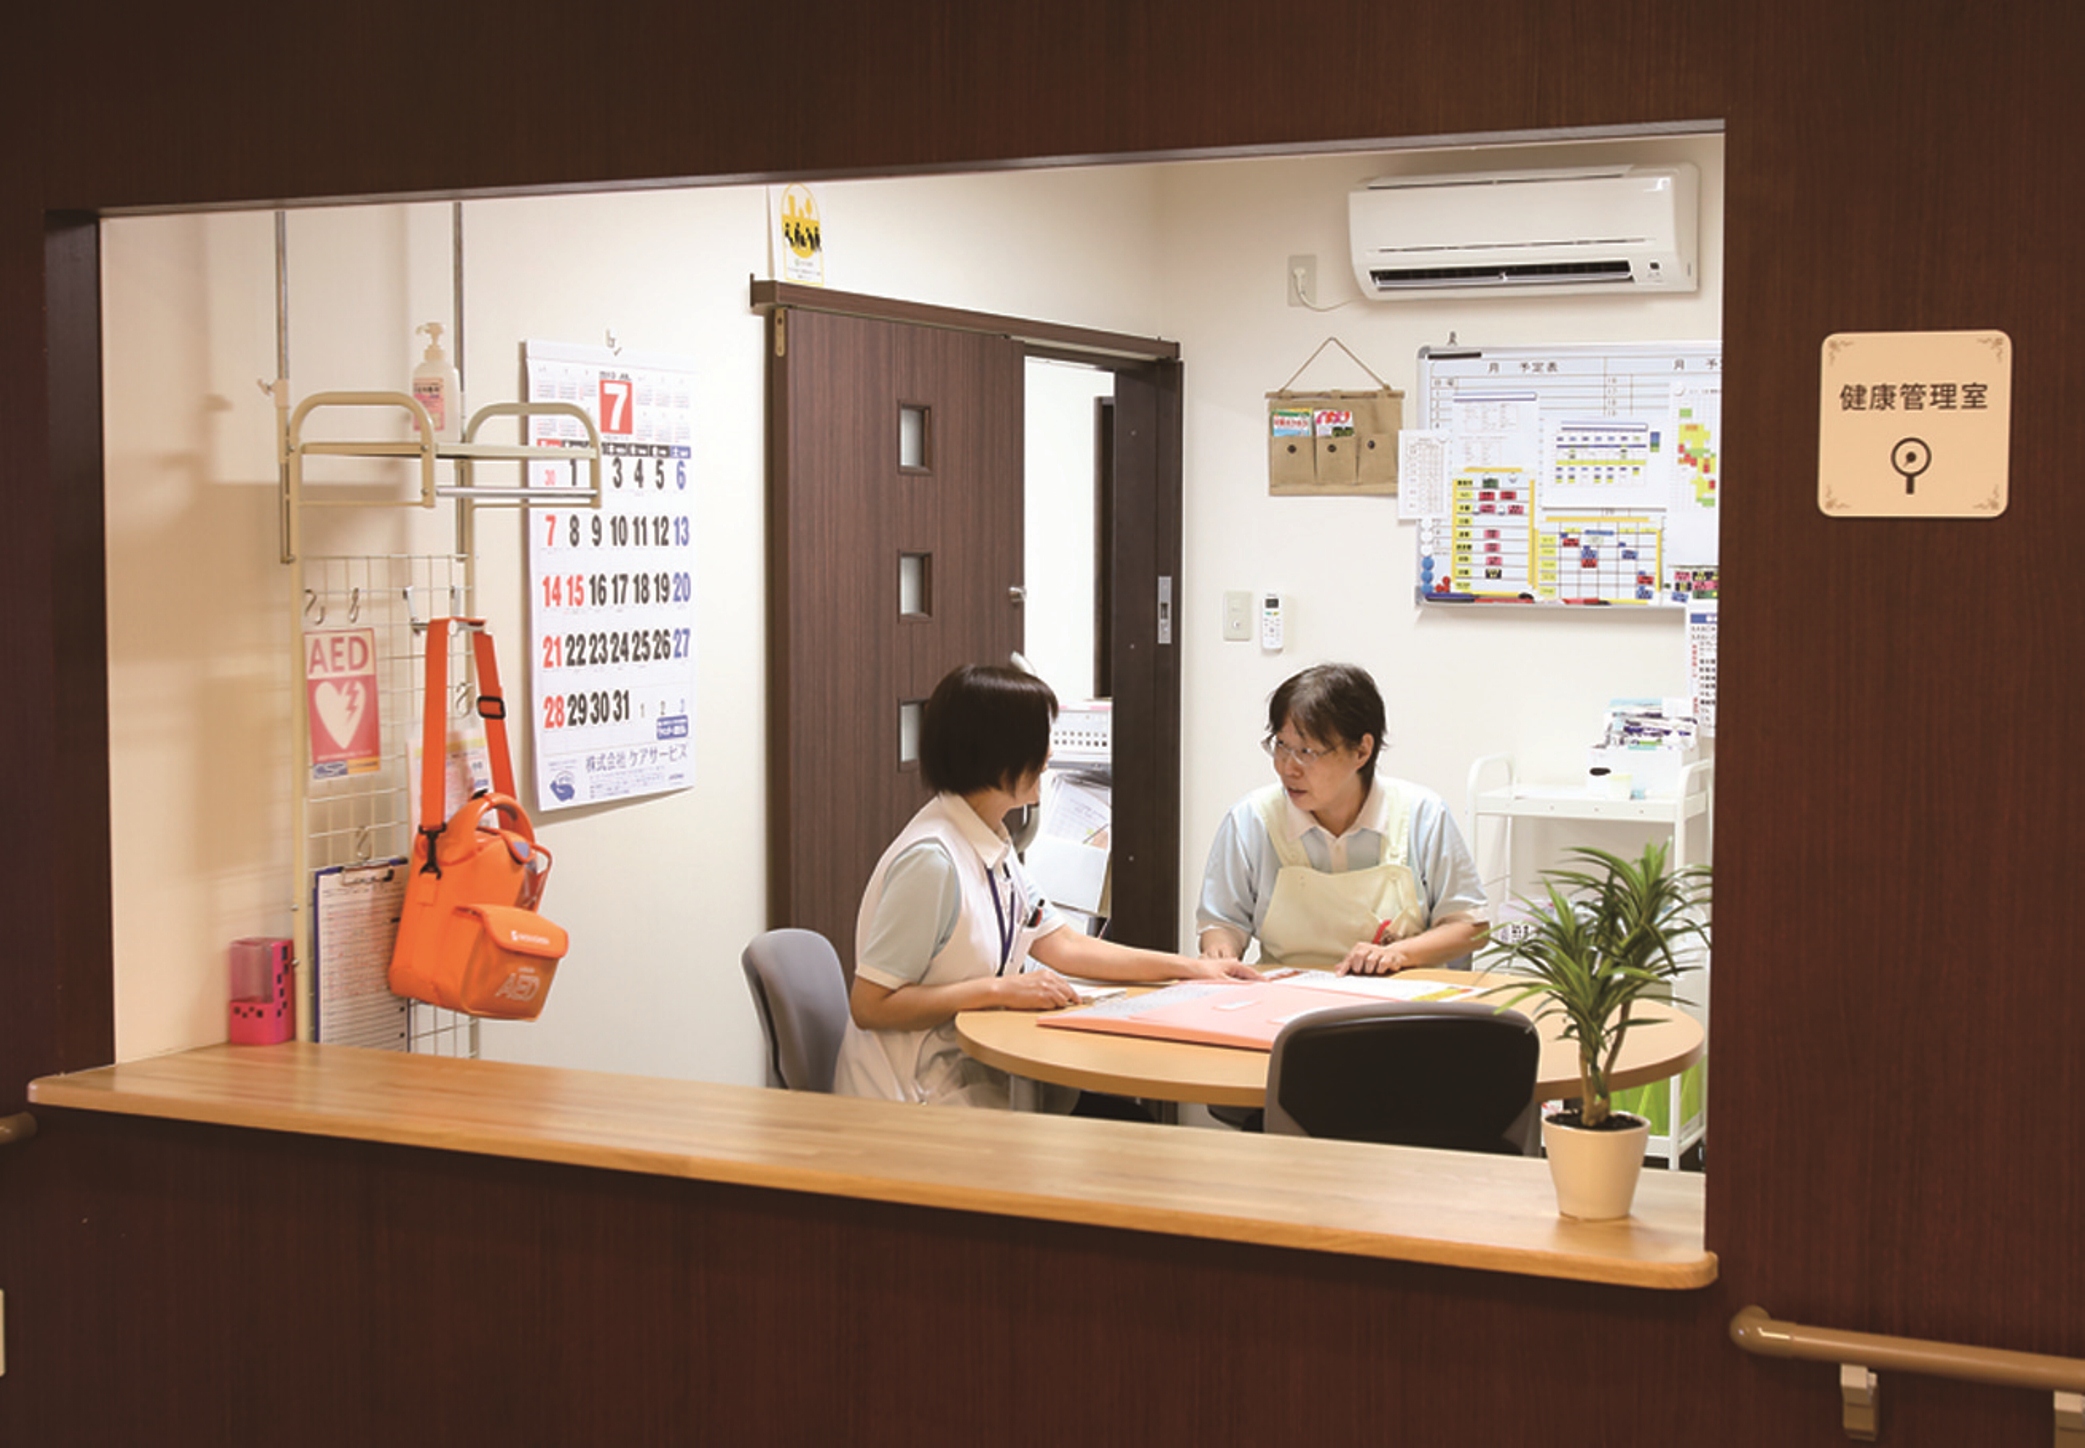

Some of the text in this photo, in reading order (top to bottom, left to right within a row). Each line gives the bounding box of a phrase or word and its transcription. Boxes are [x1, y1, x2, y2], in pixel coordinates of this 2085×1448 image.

[603, 382, 629, 432] 7
[1840, 383, 1989, 411] 健康管理室
[570, 458, 578, 487] 1
[612, 457, 623, 489] 3
[634, 458, 644, 489] 4
[655, 459, 665, 489] 5
[676, 460, 686, 490] 6
[545, 514, 690, 547] 7 8 9 10 11 12 13
[542, 571, 691, 608] 14 15 16 17 18 19 20
[309, 635, 369, 675] AED
[543, 628, 690, 669] 21 22 23 24 25 26 27
[543, 695, 565, 729] 28
[567, 693, 588, 726] 29
[590, 691, 610, 725] 30
[613, 689, 630, 722] 31
[586, 751, 627, 773] 株式会社
[629, 742, 688, 768] ケアサービス
